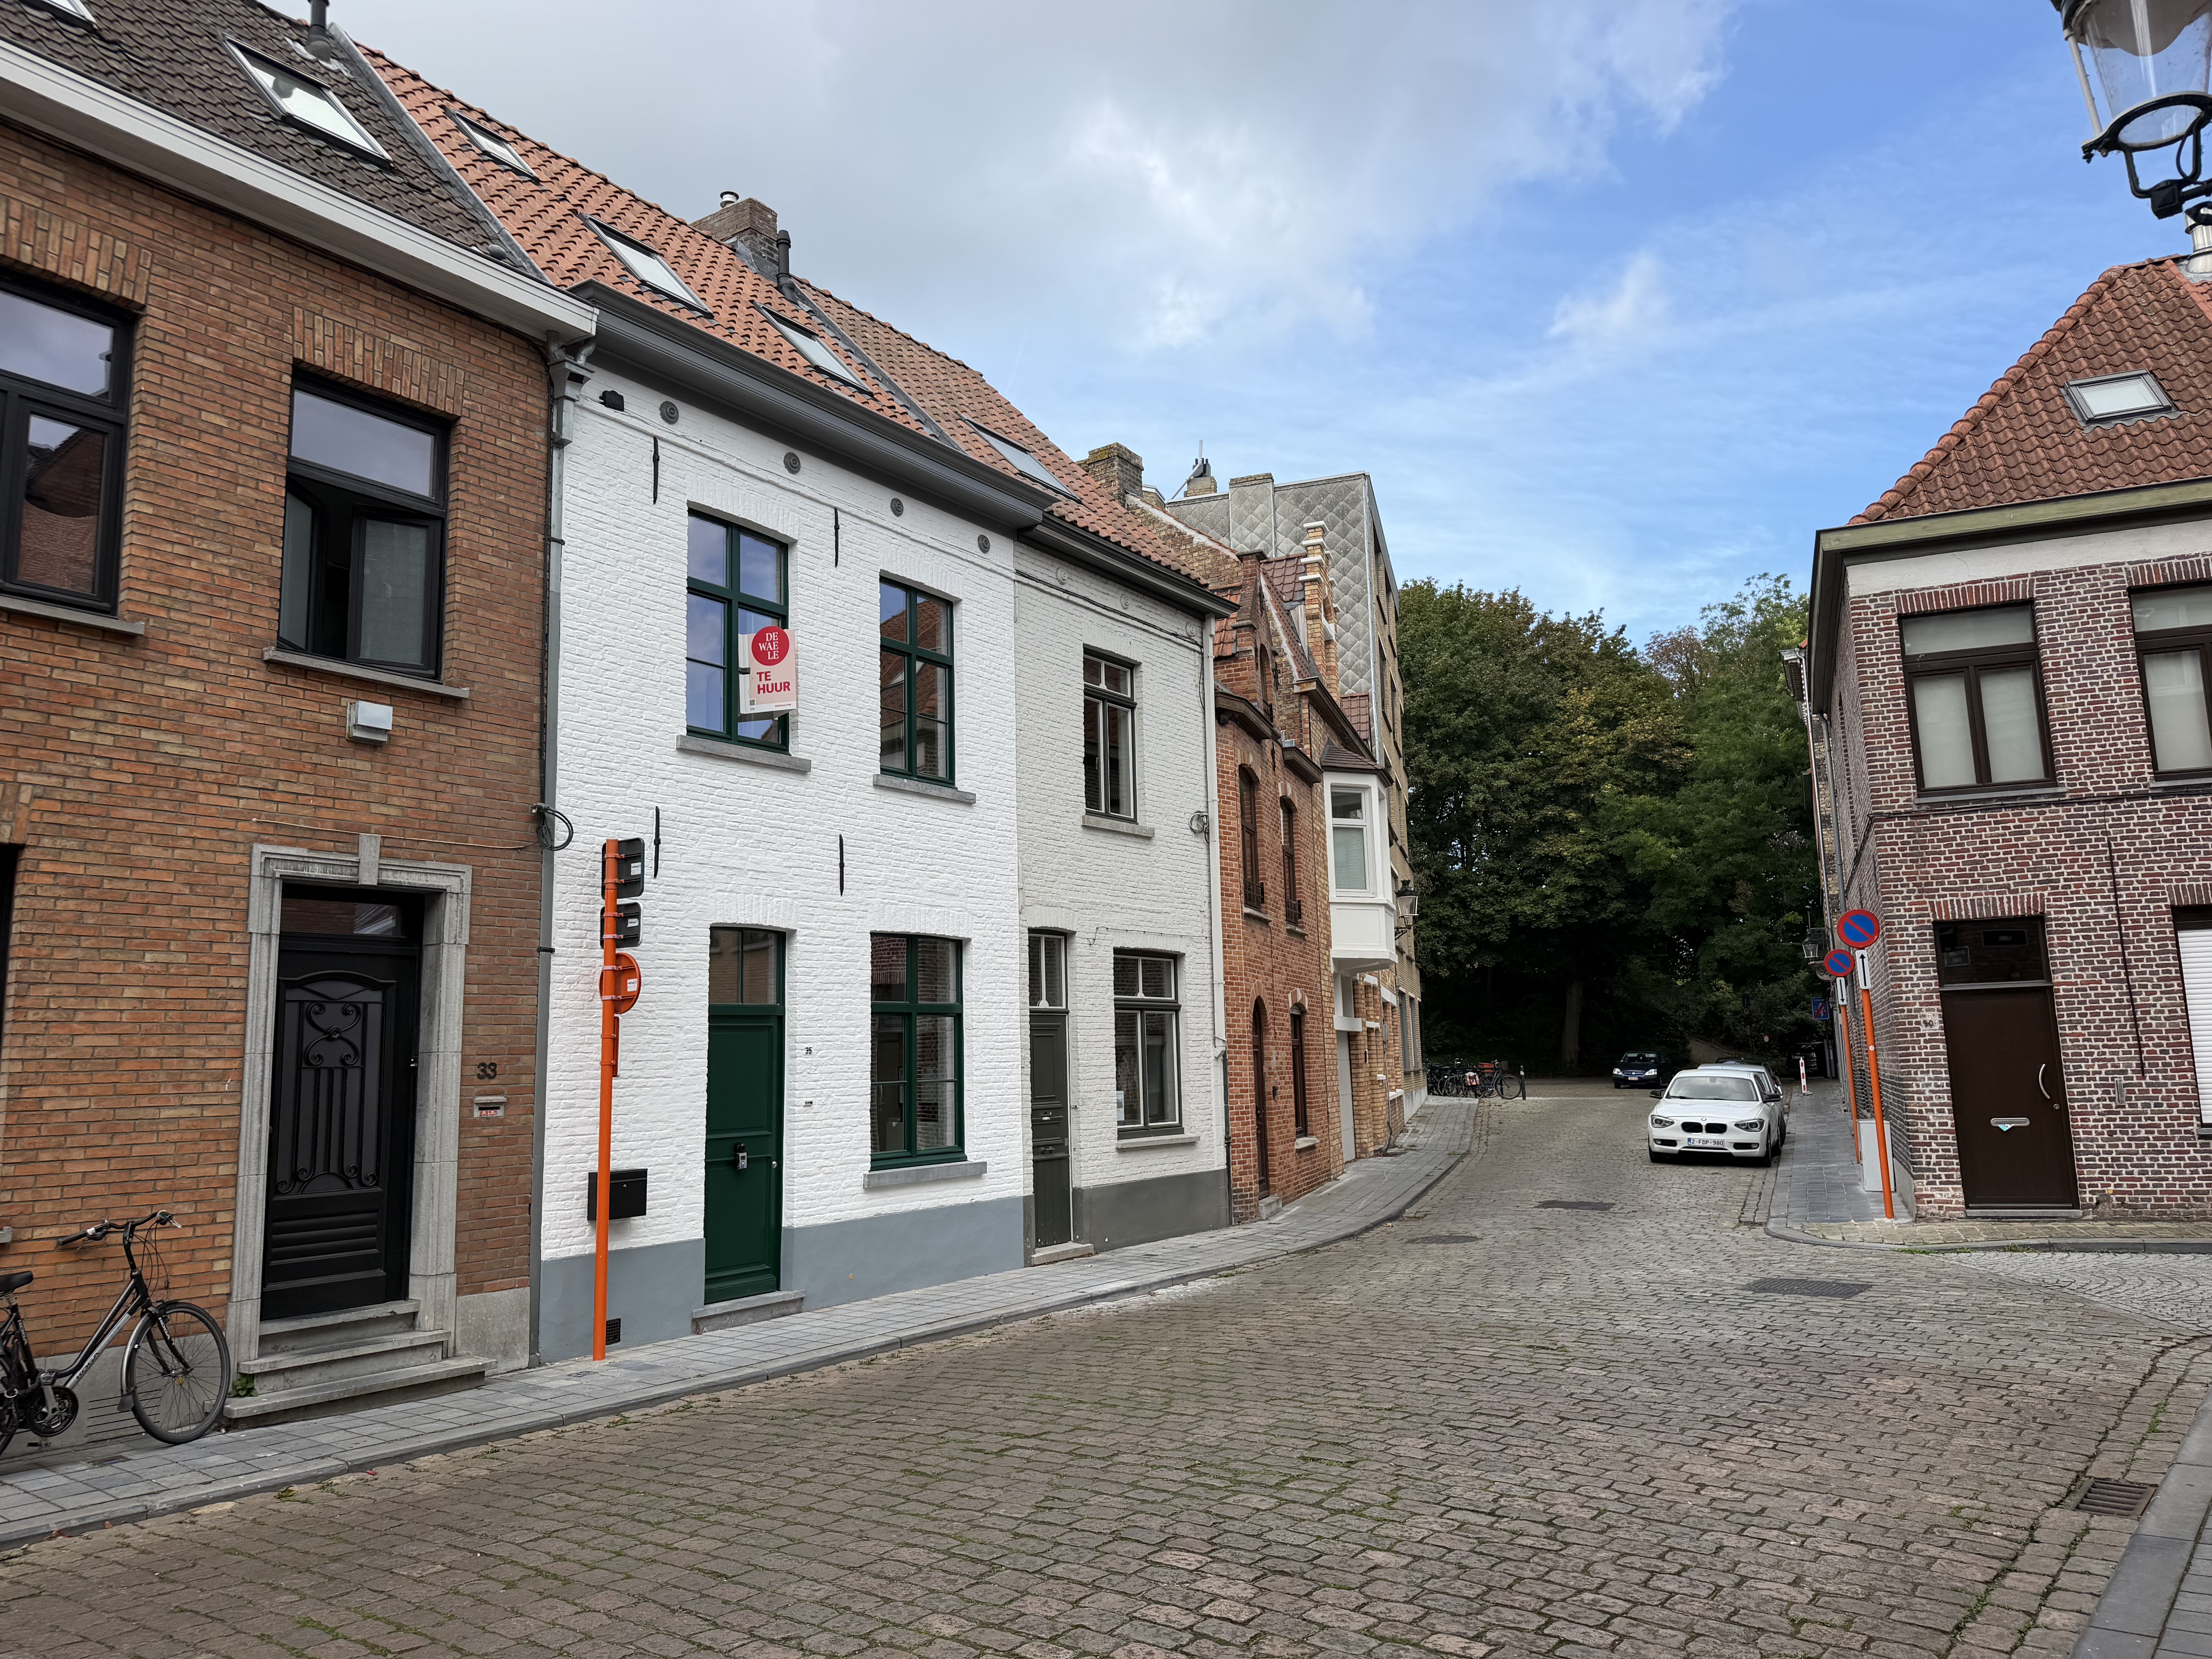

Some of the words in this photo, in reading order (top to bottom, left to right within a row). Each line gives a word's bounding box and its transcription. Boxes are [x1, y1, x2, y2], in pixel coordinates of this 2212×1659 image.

[766, 632, 778, 642] DE
[759, 641, 779, 651] WAE
[767, 651, 779, 659] LE
[756, 671, 771, 682] TE
[757, 681, 791, 694] HUUR
[477, 1062, 497, 1079] 33
[76, 1352, 100, 1379] KOGA
